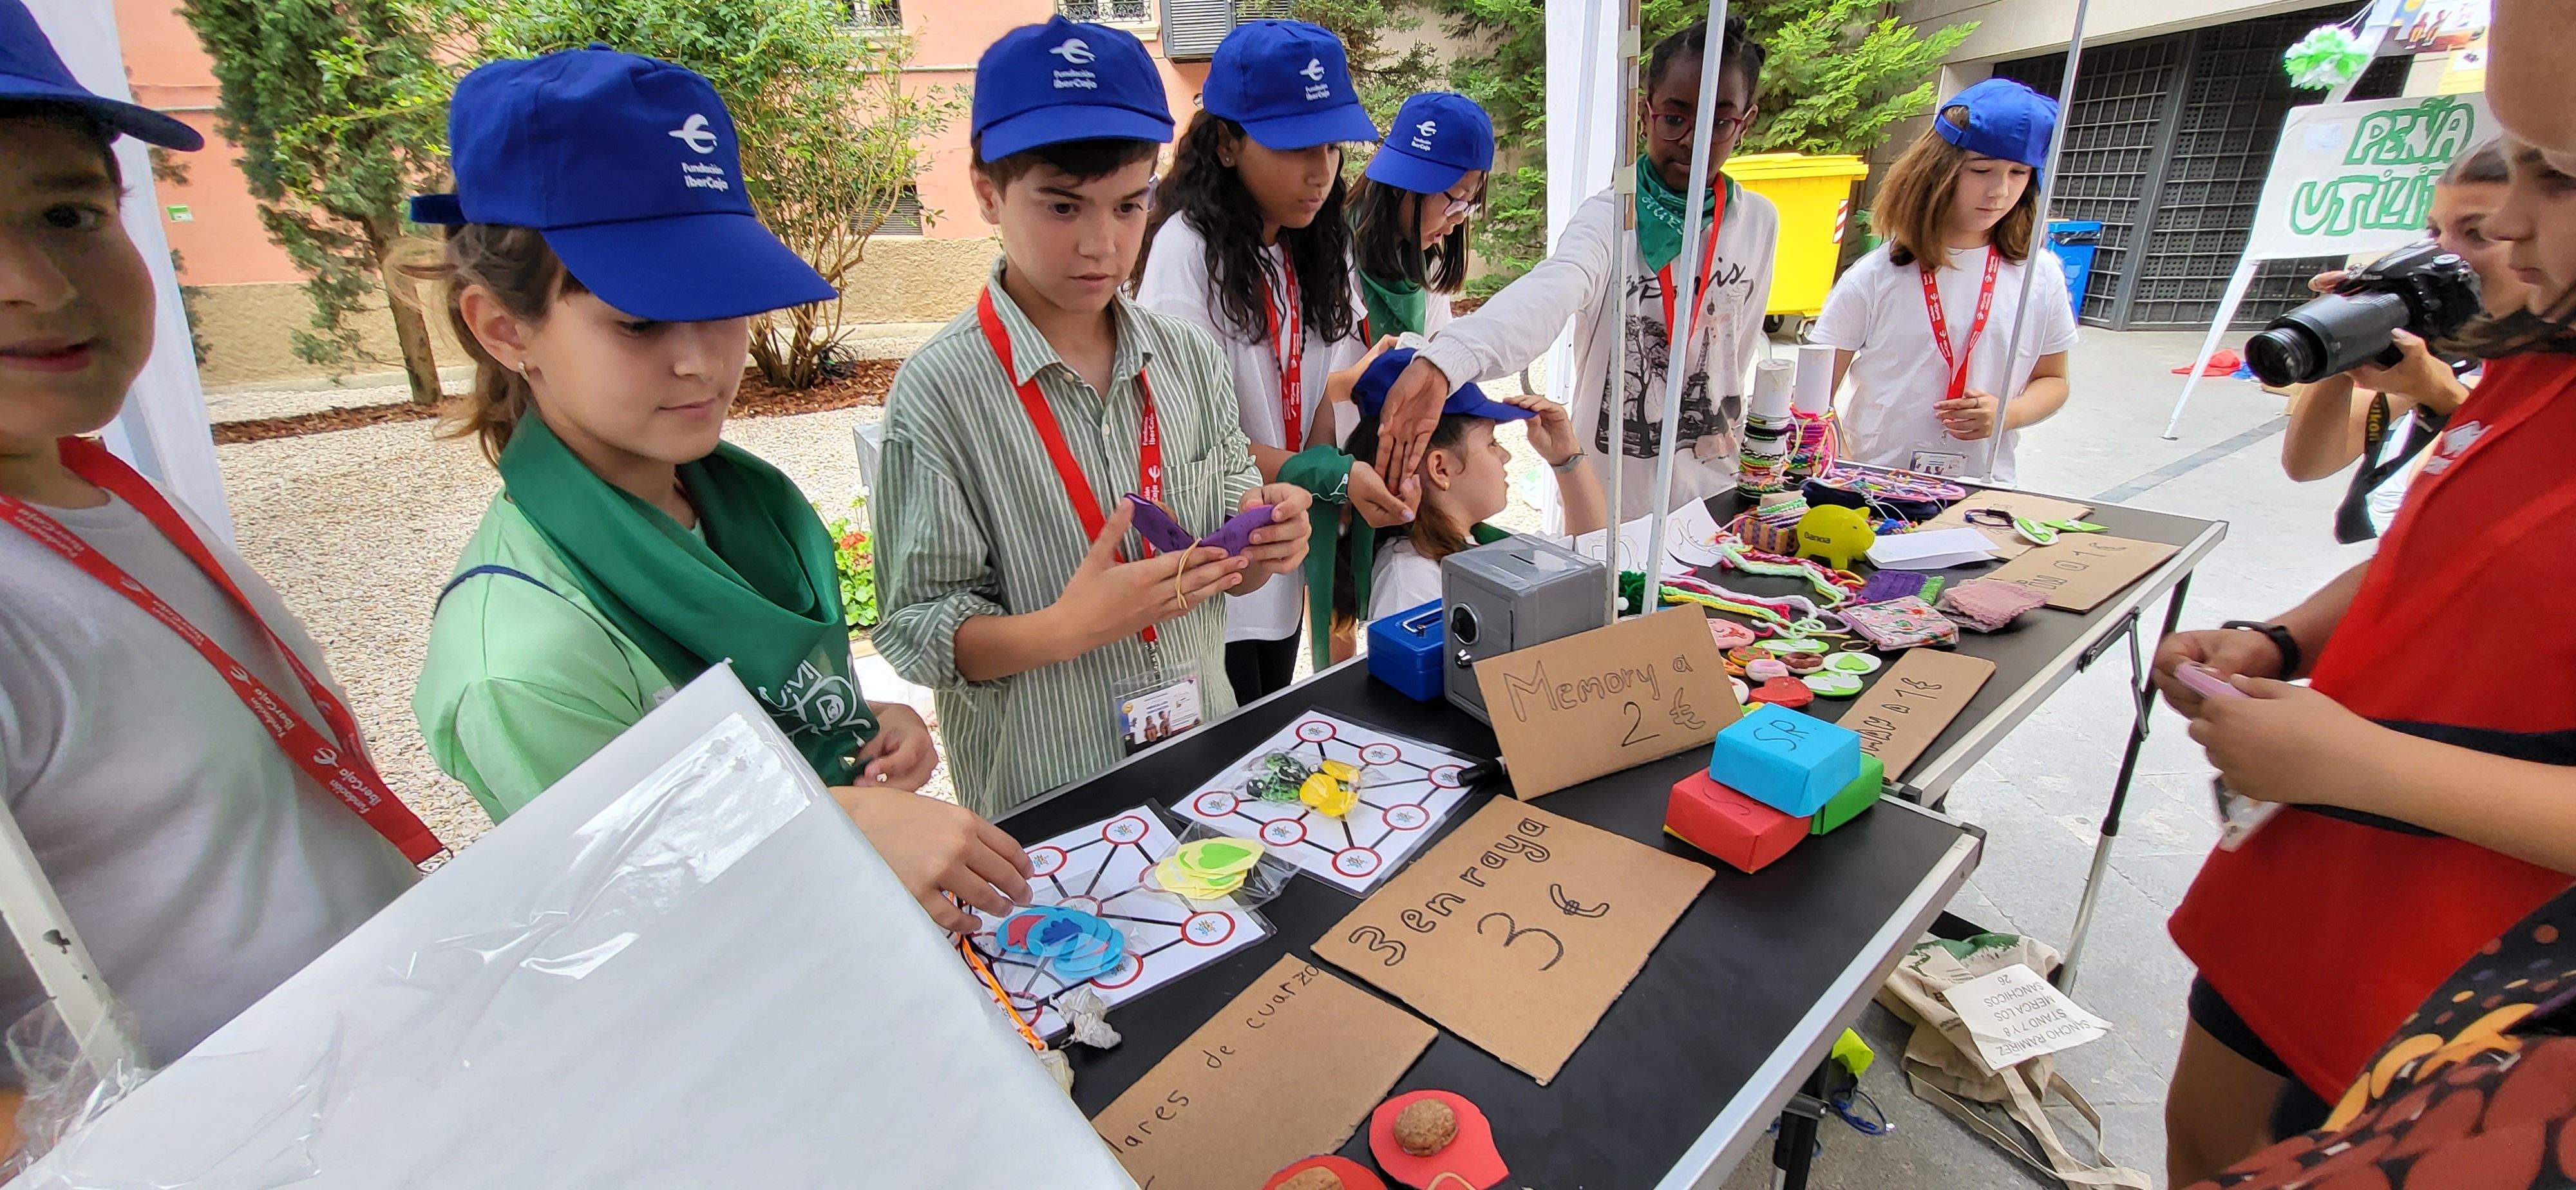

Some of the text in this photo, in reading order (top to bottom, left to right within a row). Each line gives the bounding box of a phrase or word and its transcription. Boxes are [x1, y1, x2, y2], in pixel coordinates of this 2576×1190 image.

[1502, 654, 1694, 722] Memory a
[1621, 701, 1661, 748] 2
[1348, 817, 1551, 967] 3 en raya
[1477, 911, 1564, 971] 3
[1997, 974, 2012, 986] 26
[1984, 982, 2045, 1008] SANCHICOS
[1994, 994, 2056, 1022] MERCA LOS
[2022, 1021, 2029, 1031] 7
[2029, 1008, 2067, 1028] STAND
[2045, 1020, 2090, 1039] SANCHO
[2003, 1027, 2011, 1037] 8
[1096, 964, 1320, 1154] lares de cuarzo
